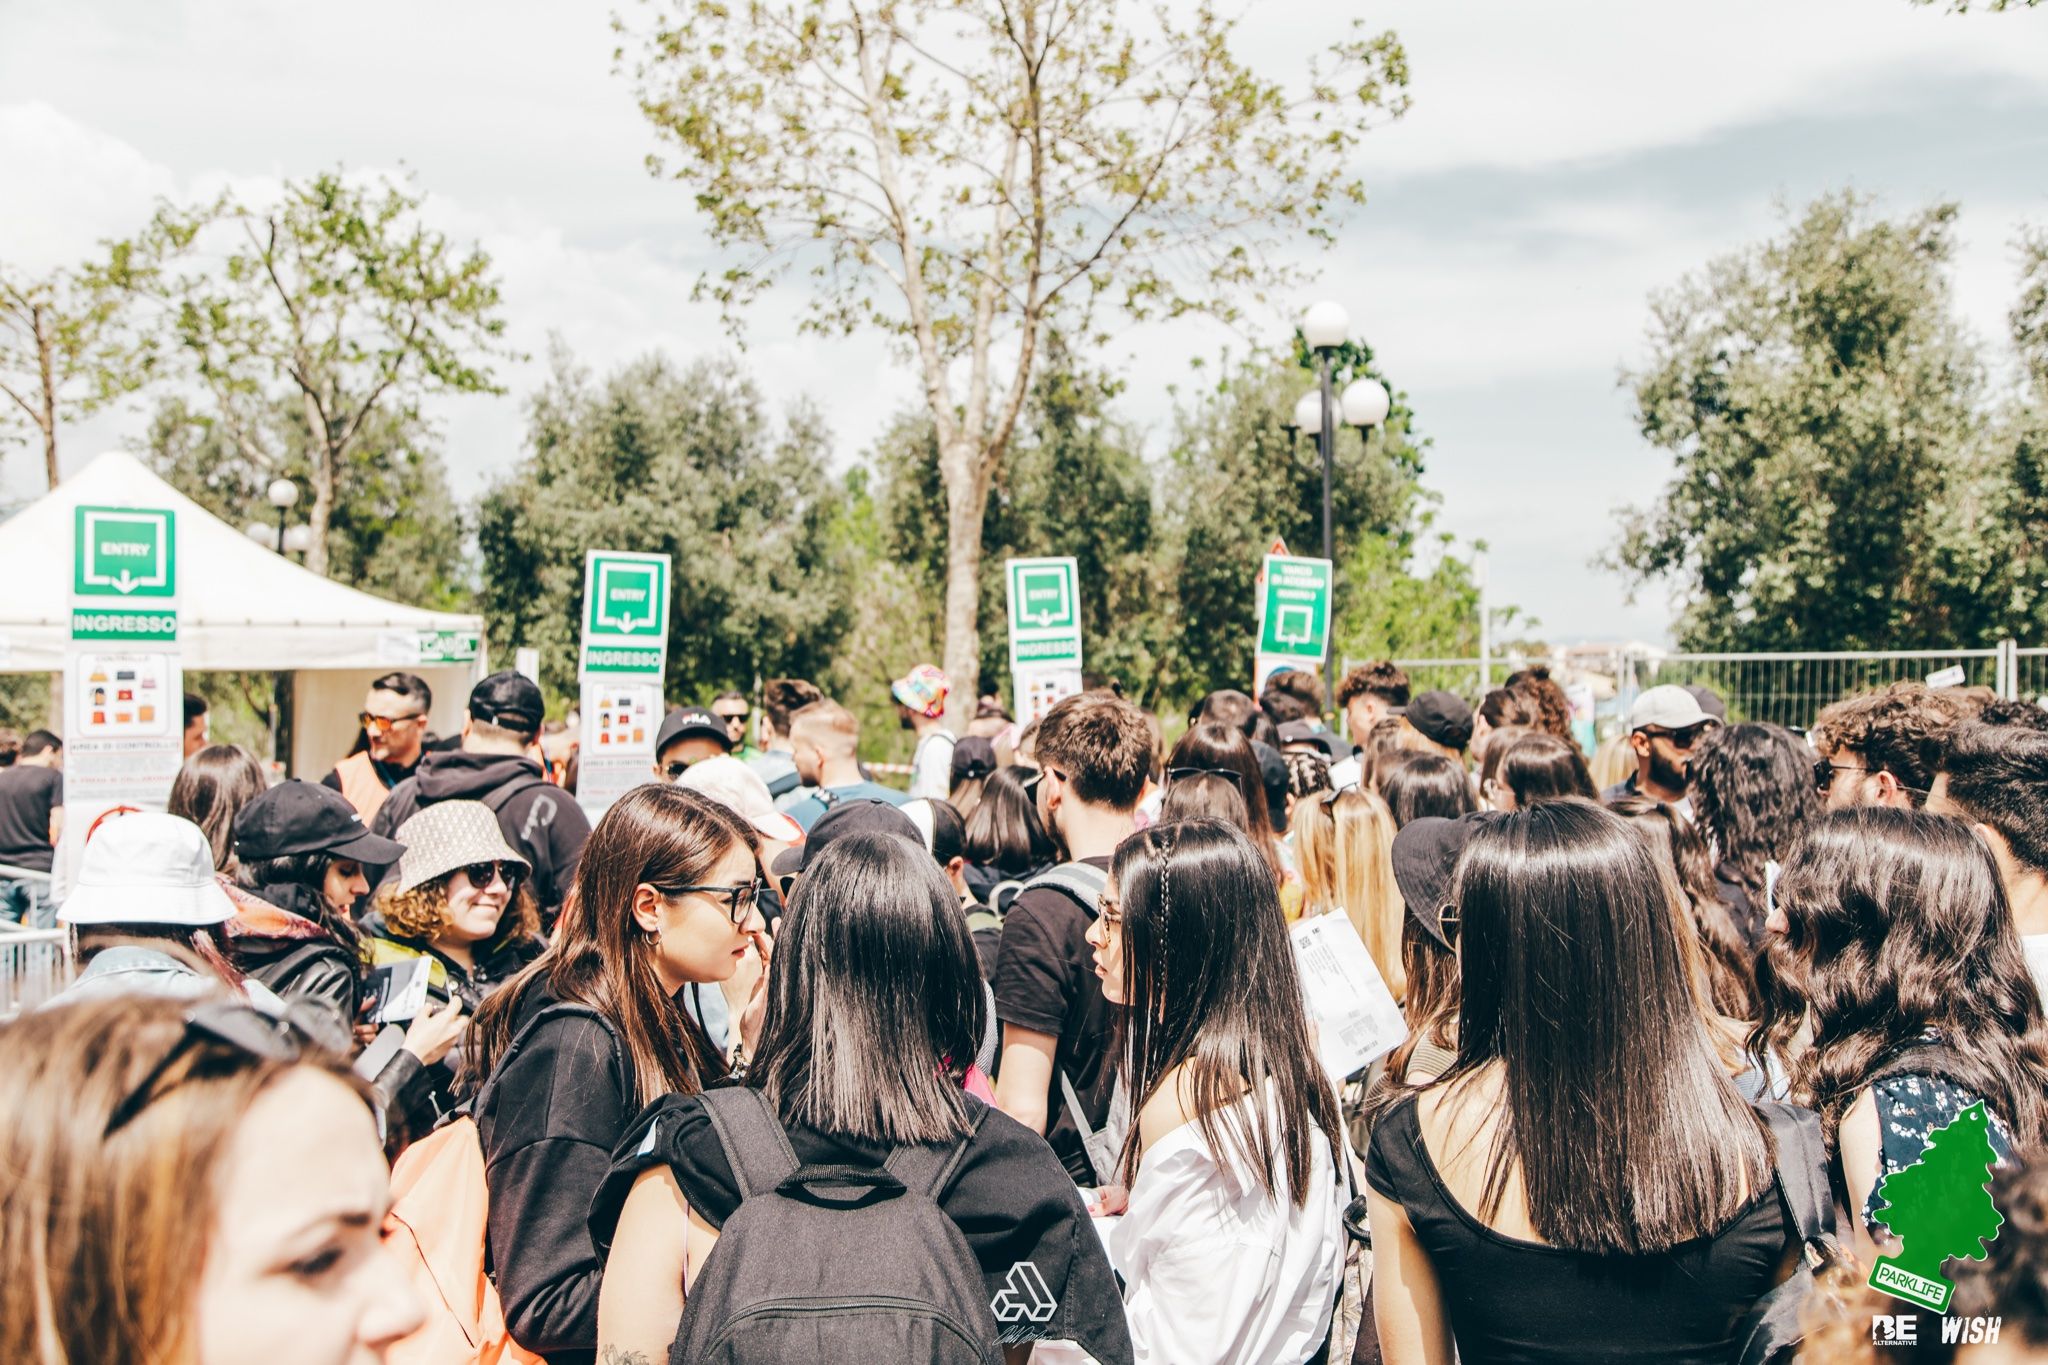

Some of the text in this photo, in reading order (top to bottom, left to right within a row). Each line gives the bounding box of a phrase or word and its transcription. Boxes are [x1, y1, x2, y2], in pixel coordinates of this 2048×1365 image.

[101, 542, 150, 556] ENTRY
[610, 588, 646, 602] ENTRY
[73, 614, 176, 632] INGRESSO
[1017, 640, 1076, 657] INGRESSO
[587, 650, 660, 667] INGRESSO
